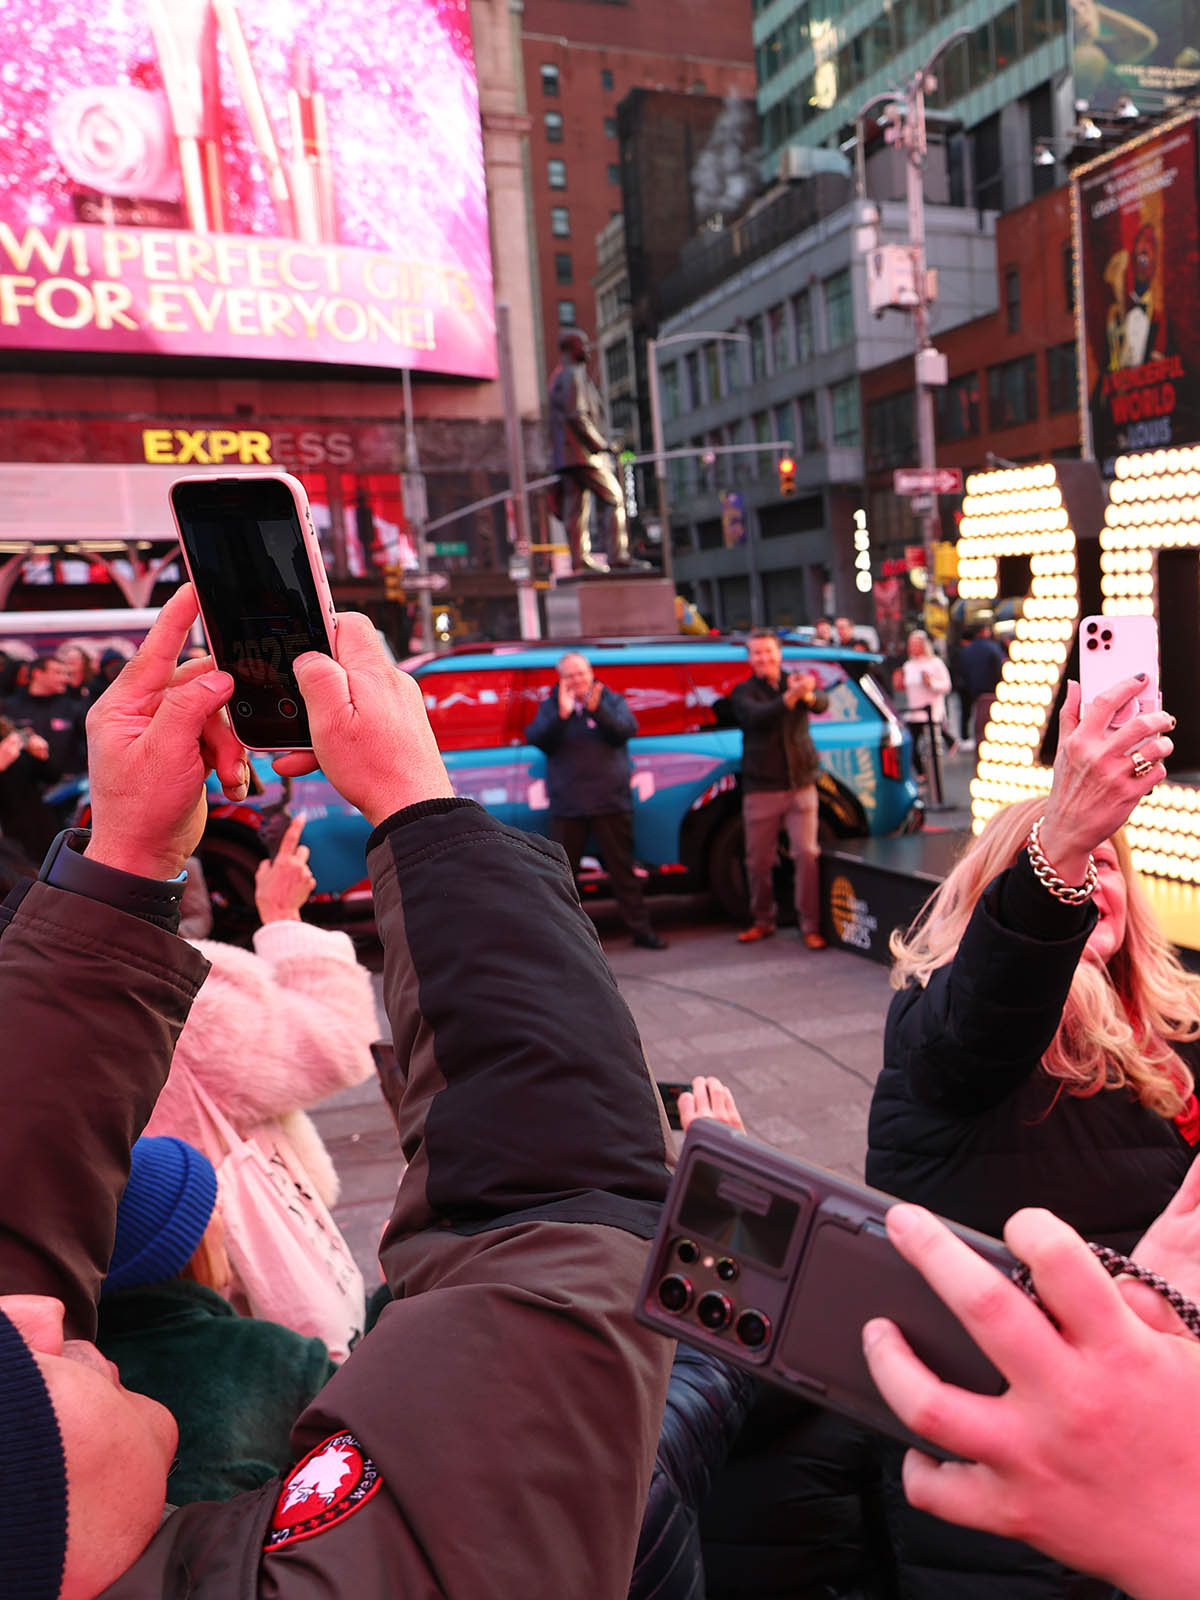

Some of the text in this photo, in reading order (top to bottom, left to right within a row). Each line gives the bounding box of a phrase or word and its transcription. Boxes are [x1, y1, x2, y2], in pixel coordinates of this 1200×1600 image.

[103, 230, 347, 292] PERFECT
[362, 256, 475, 312] GIFTS
[0, 274, 436, 351] FOR EVERYONE!
[1111, 382, 1177, 425] WORLD
[142, 428, 354, 466] EXPRESS
[853, 508, 873, 593] 1540
